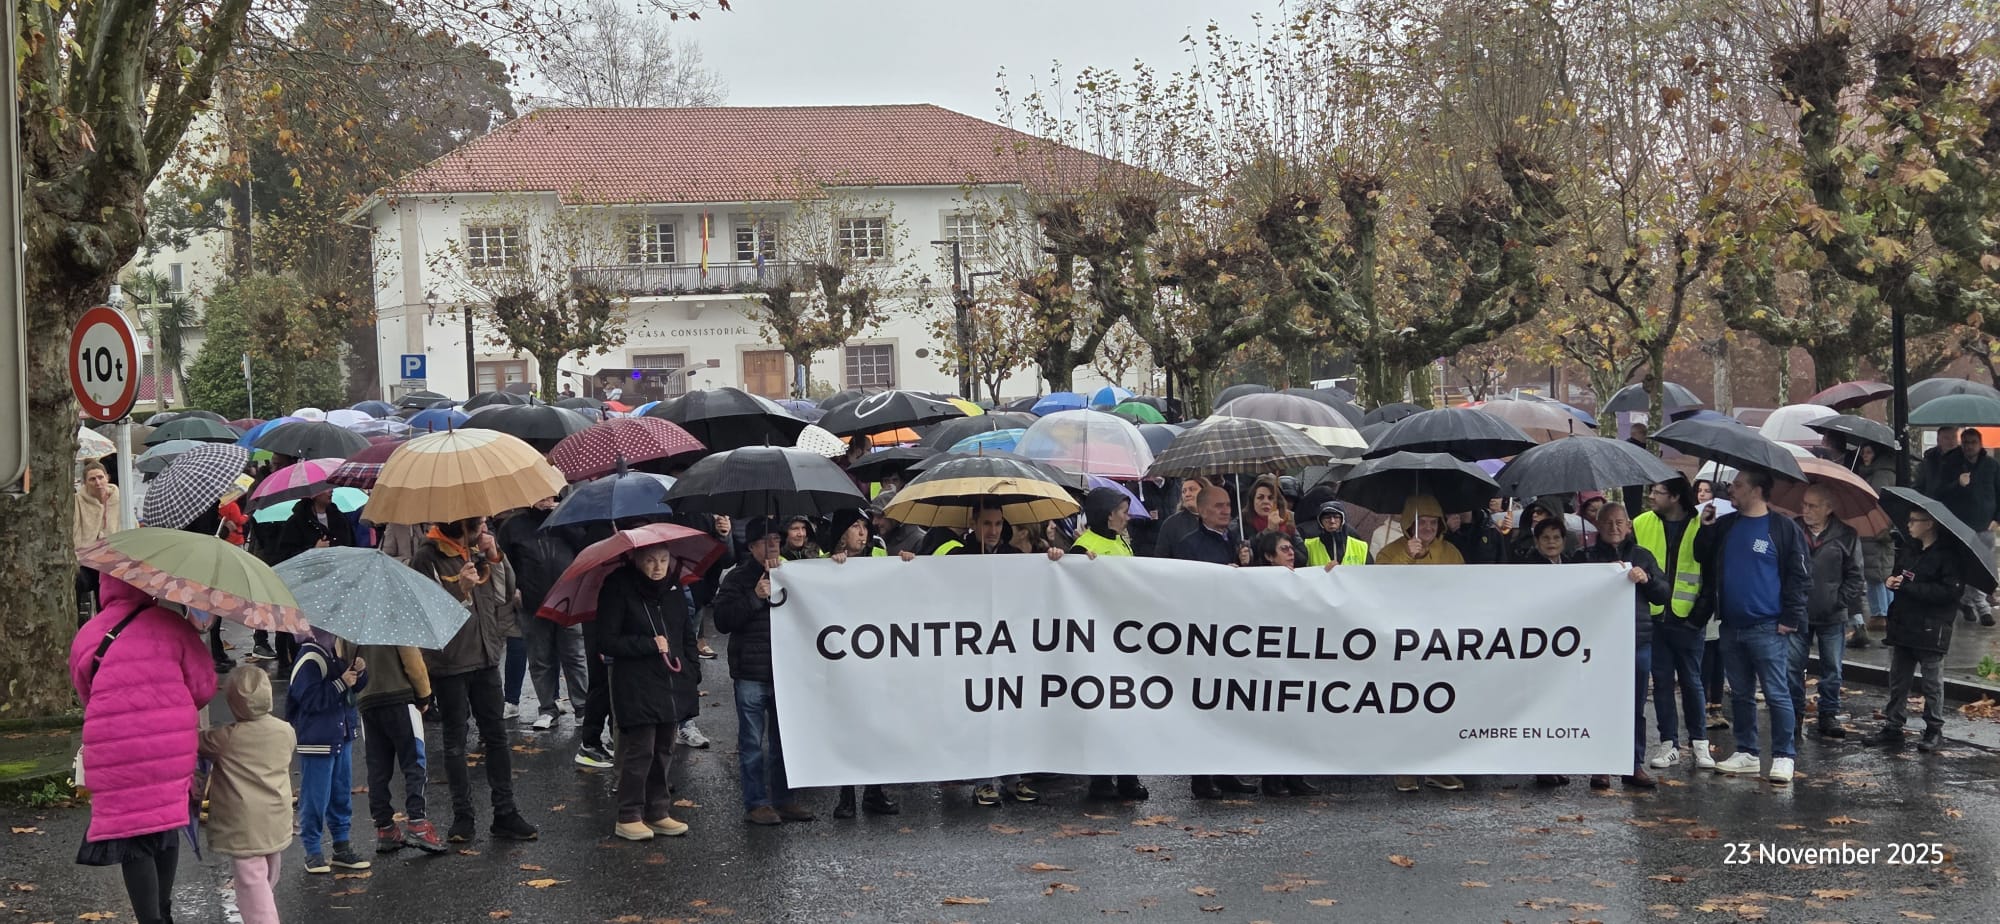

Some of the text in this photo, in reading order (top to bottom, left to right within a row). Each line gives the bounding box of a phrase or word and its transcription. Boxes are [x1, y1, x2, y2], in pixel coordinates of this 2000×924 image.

[638, 327, 747, 338] CASA CONSISTORIAL
[405, 357, 421, 377] P
[816, 618, 1592, 664] CONTRA UN CONCELLO PARADO,
[965, 674, 1456, 714] UN POBO UNIFICADO
[1458, 727, 1591, 740] CAMBRE EN LOITA
